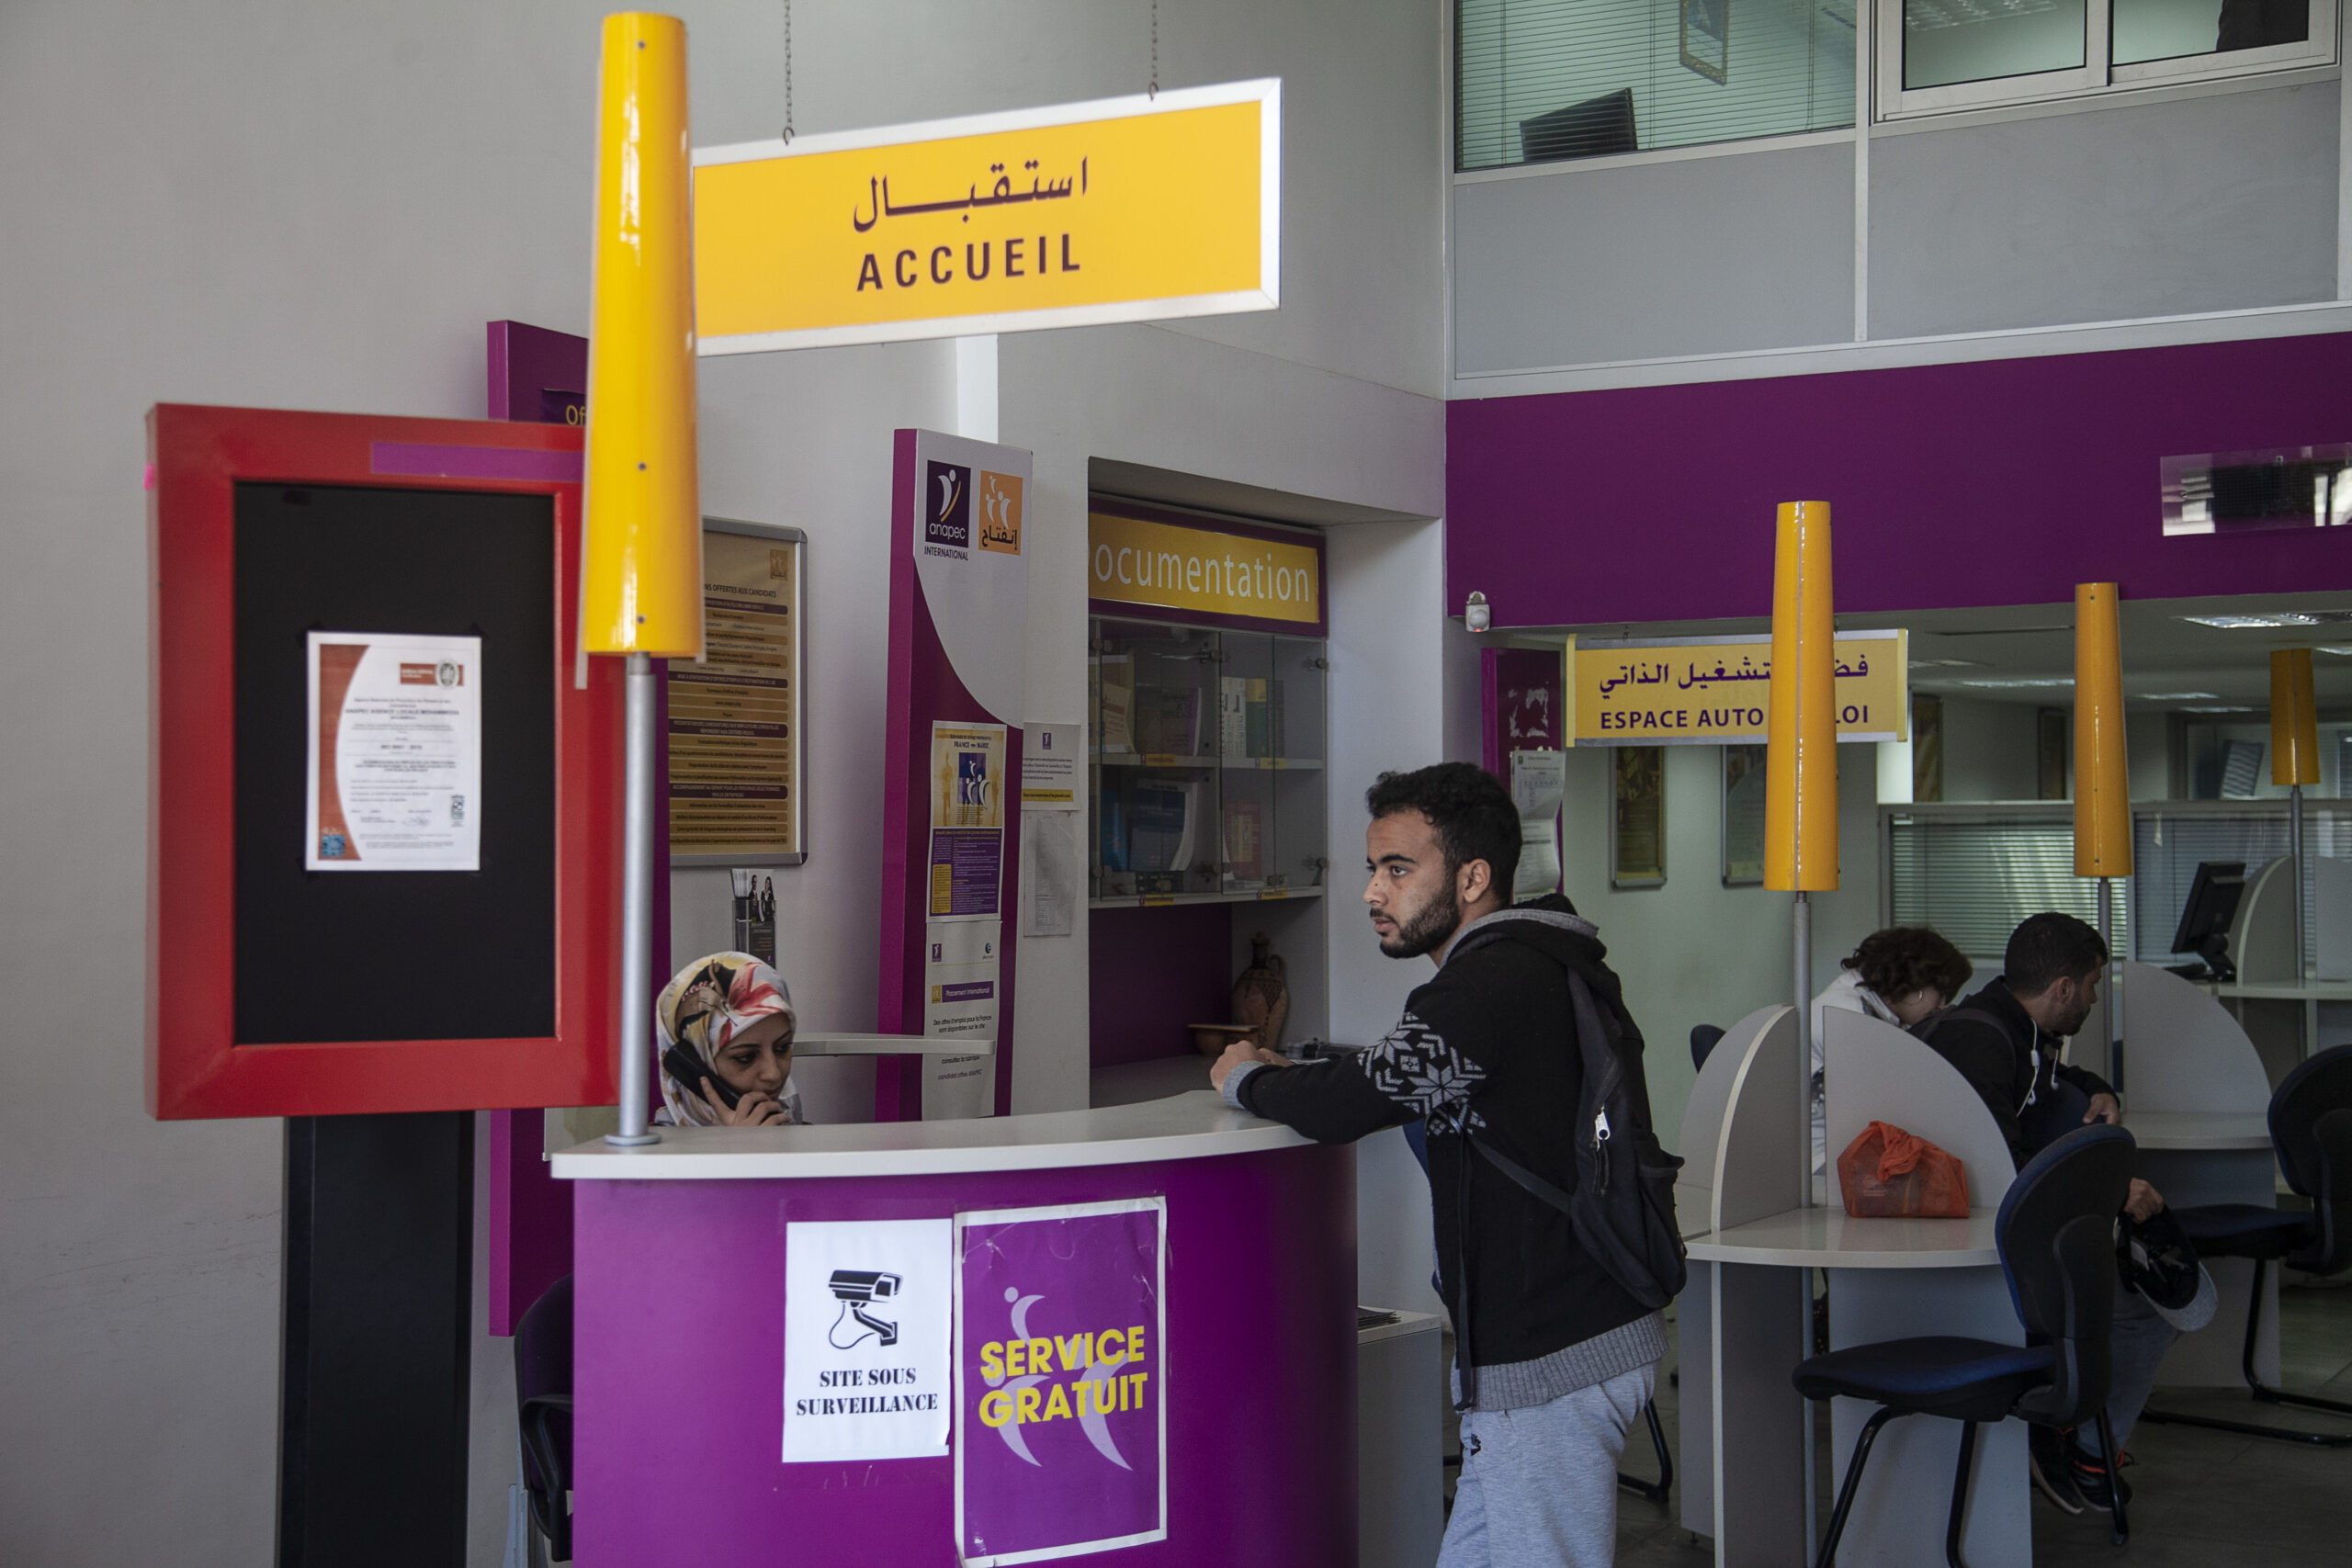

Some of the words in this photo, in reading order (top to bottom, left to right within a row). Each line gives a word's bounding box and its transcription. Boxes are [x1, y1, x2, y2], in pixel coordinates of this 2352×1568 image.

[853, 155, 1088, 233] استقبال
[857, 232, 1081, 292] ACCUEIL
[929, 521, 967, 540] anapec
[924, 545, 969, 561] INTERNATIONAL
[1088, 543, 1311, 603] ocumentation
[713, 585, 738, 595] OFFERTES
[738, 587, 748, 595] AUX
[748, 588, 777, 599] CANDIDATS
[1600, 662, 1669, 700] الذاتي
[1600, 710, 1689, 729] ESPACE
[1697, 707, 1765, 728] AUTO
[978, 1325, 1146, 1380] SERVICE
[820, 1369, 864, 1388] SITE
[868, 1367, 917, 1386] SOUS
[796, 1393, 938, 1416] SURVEILLANCE
[978, 1372, 1148, 1428] GRATUIT
